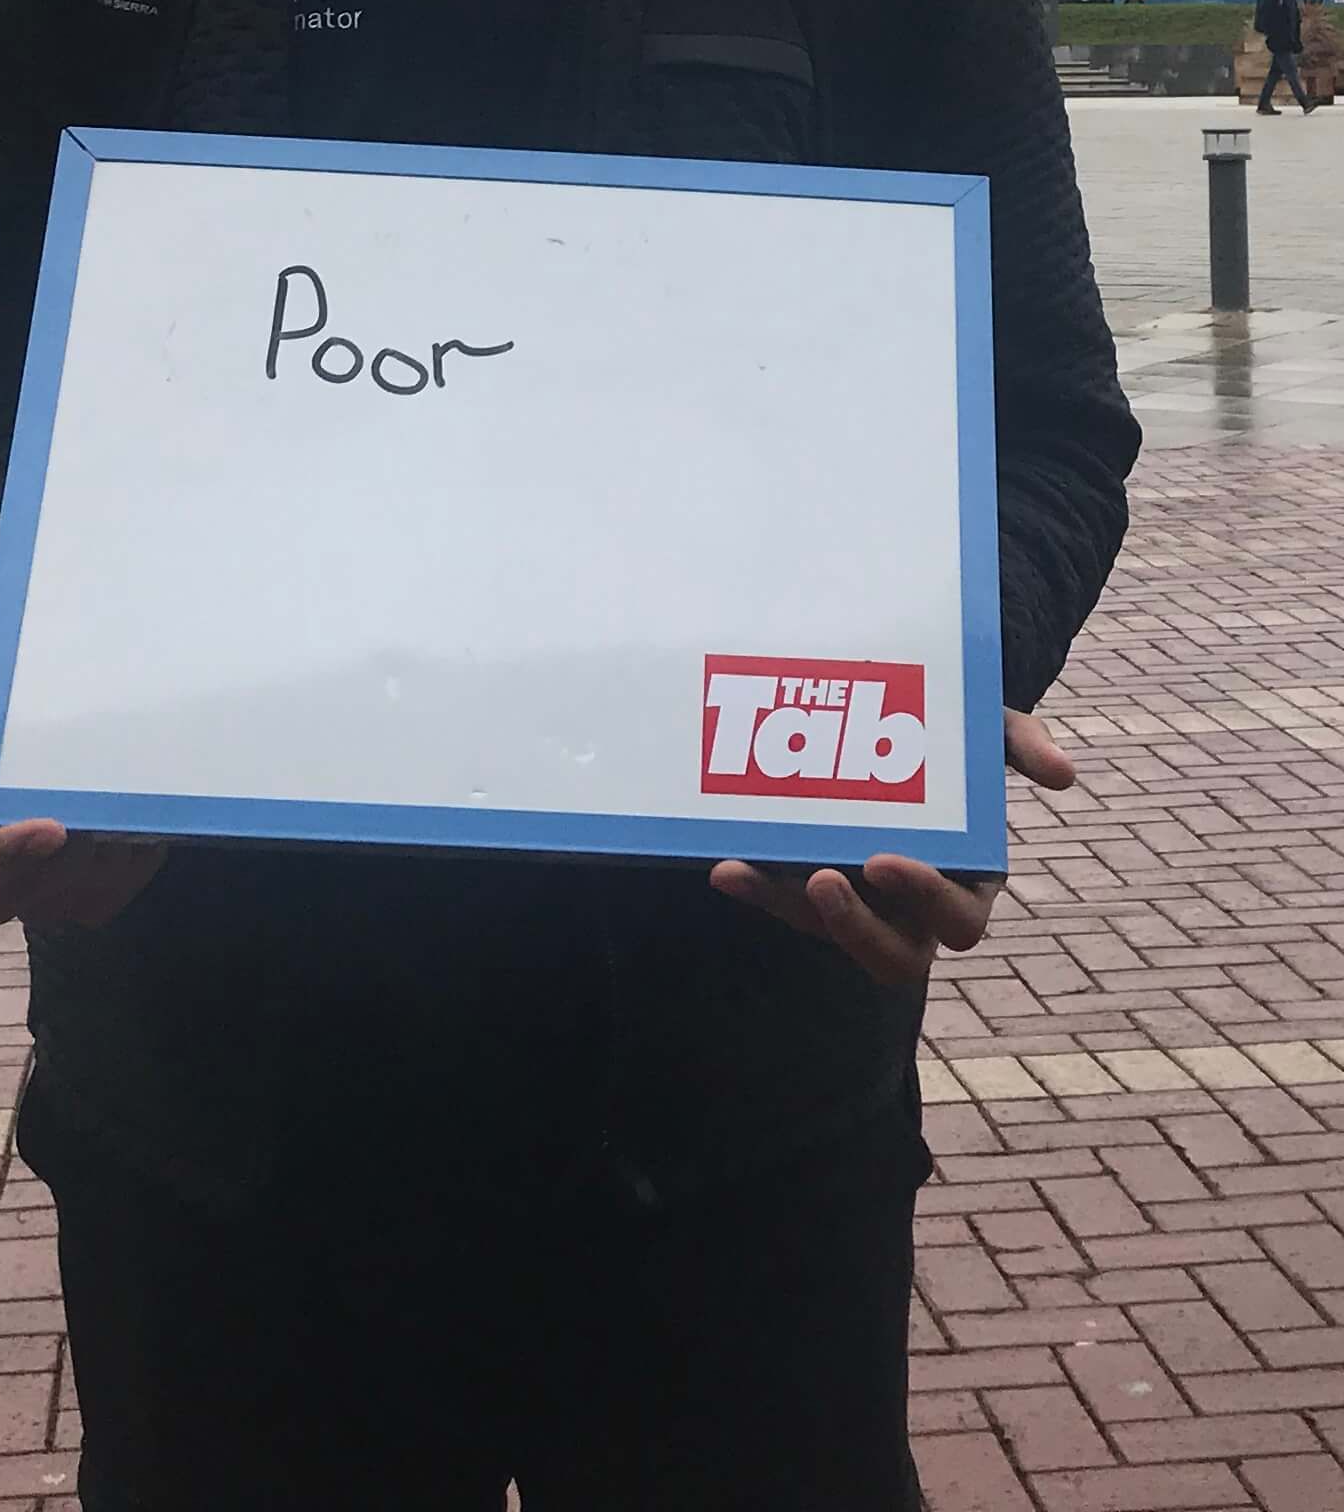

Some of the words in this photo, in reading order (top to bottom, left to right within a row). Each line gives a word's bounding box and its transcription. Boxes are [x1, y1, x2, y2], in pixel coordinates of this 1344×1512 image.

[294, 7, 362, 31] nator
[266, 265, 514, 395] Poor
[779, 676, 850, 707] THE
[705, 673, 926, 784] Tab
